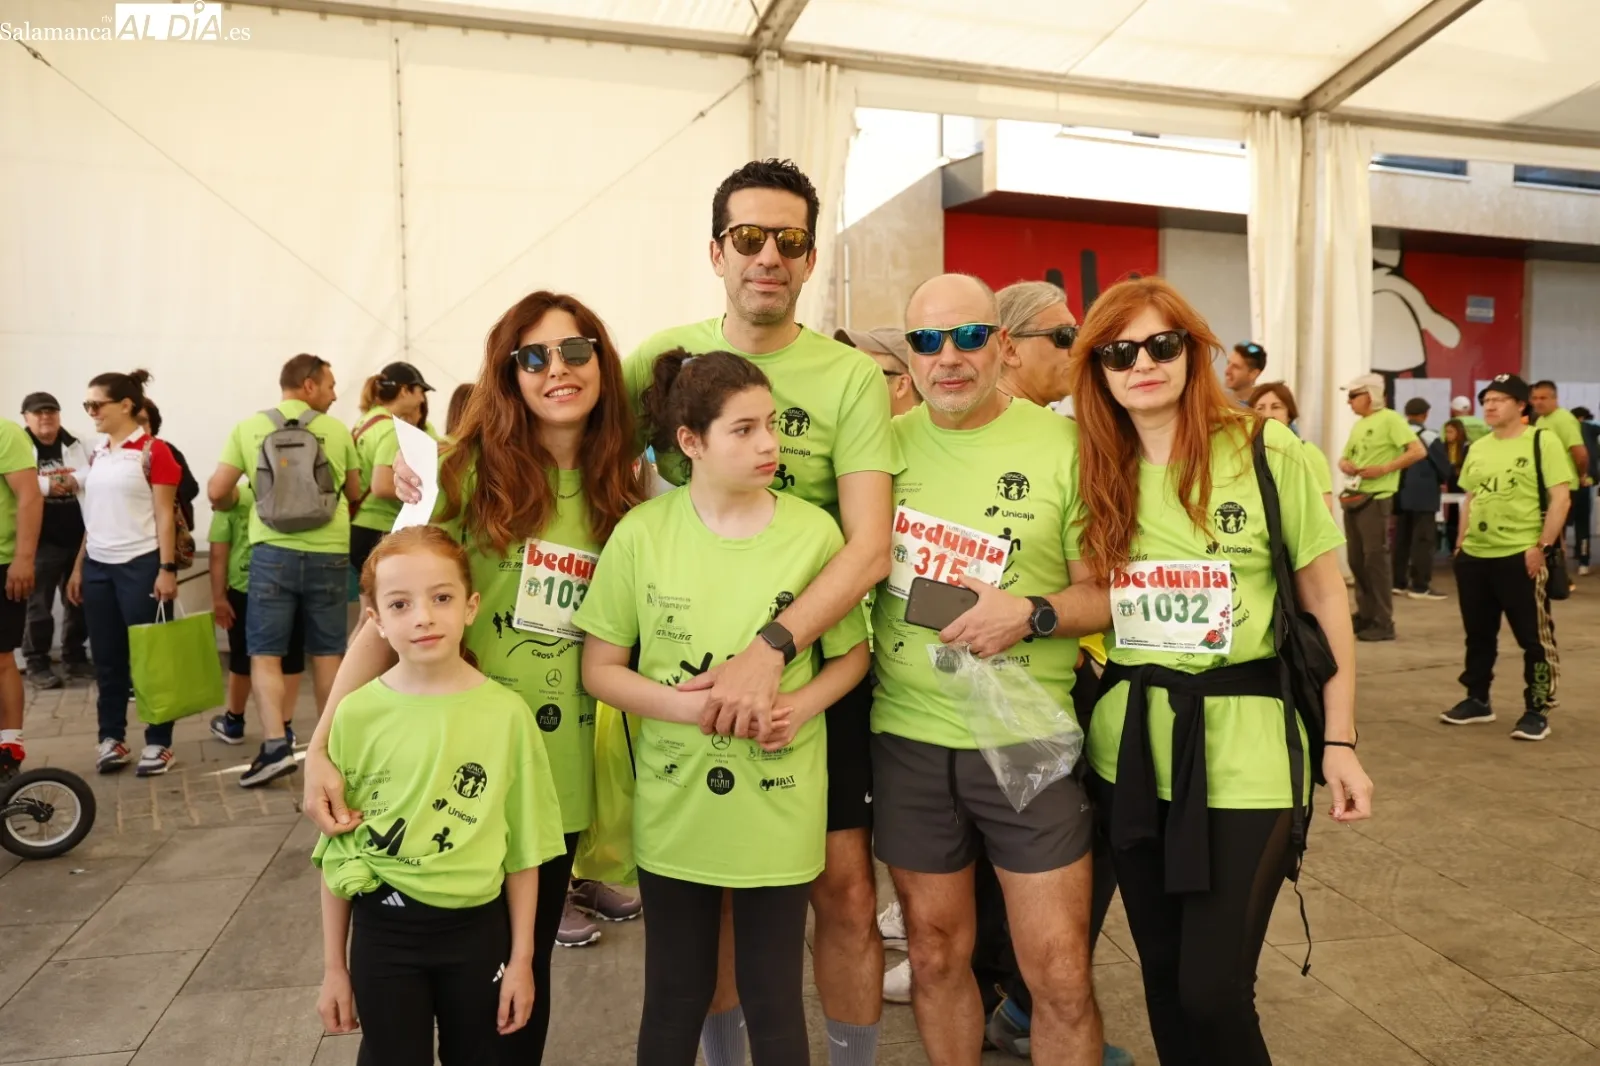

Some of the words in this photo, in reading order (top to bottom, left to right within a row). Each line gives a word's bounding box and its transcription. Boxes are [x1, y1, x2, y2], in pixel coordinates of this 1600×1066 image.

[780, 446, 811, 458] Unicaja
[1002, 510, 1035, 521] Unicaja
[895, 511, 1005, 567] bedunia
[1222, 545, 1252, 555] Unicaja
[914, 546, 968, 588] 315
[1113, 565, 1229, 589] bedunia
[1136, 593, 1210, 624] 1032
[531, 649, 554, 660] CROSS
[448, 806, 477, 825] Unicaja
